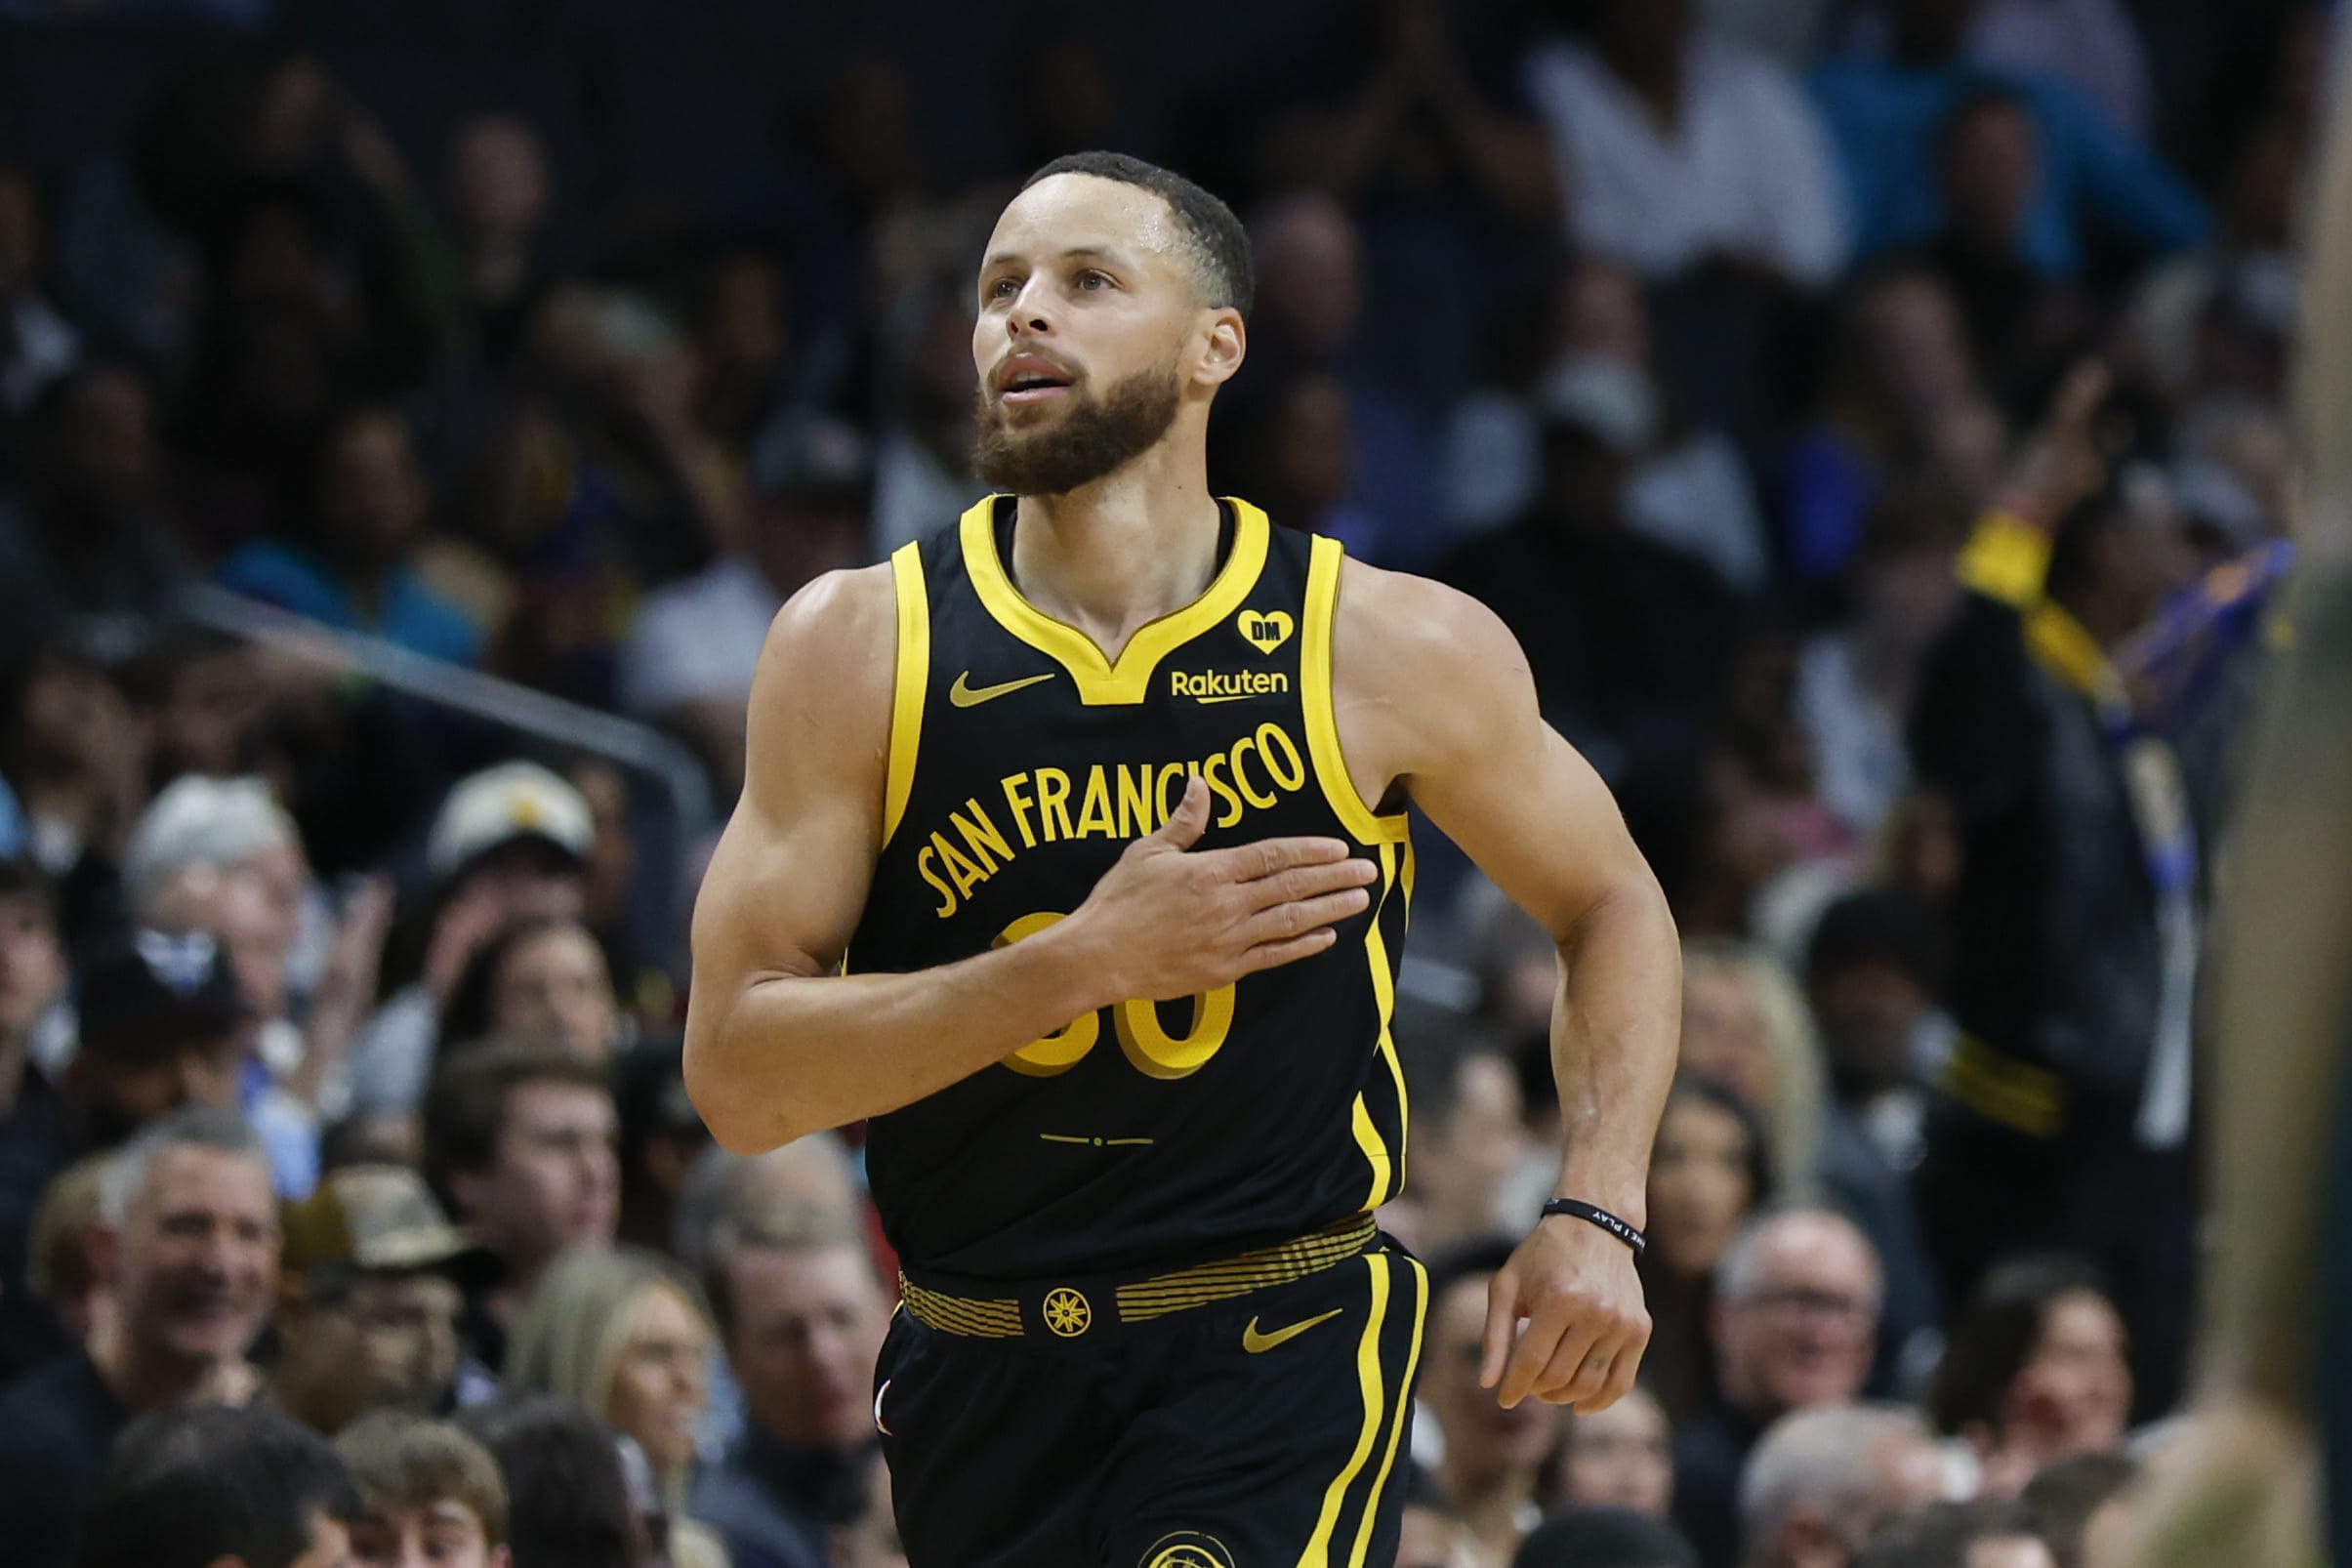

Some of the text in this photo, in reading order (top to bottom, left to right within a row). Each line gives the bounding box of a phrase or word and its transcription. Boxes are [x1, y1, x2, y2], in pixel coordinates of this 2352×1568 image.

[1251, 621, 1280, 640] DM
[1172, 669, 1288, 696] Rakuten
[918, 722, 1305, 918] SAN FRANCSCO
[1592, 1212, 1623, 1232] PLAY
